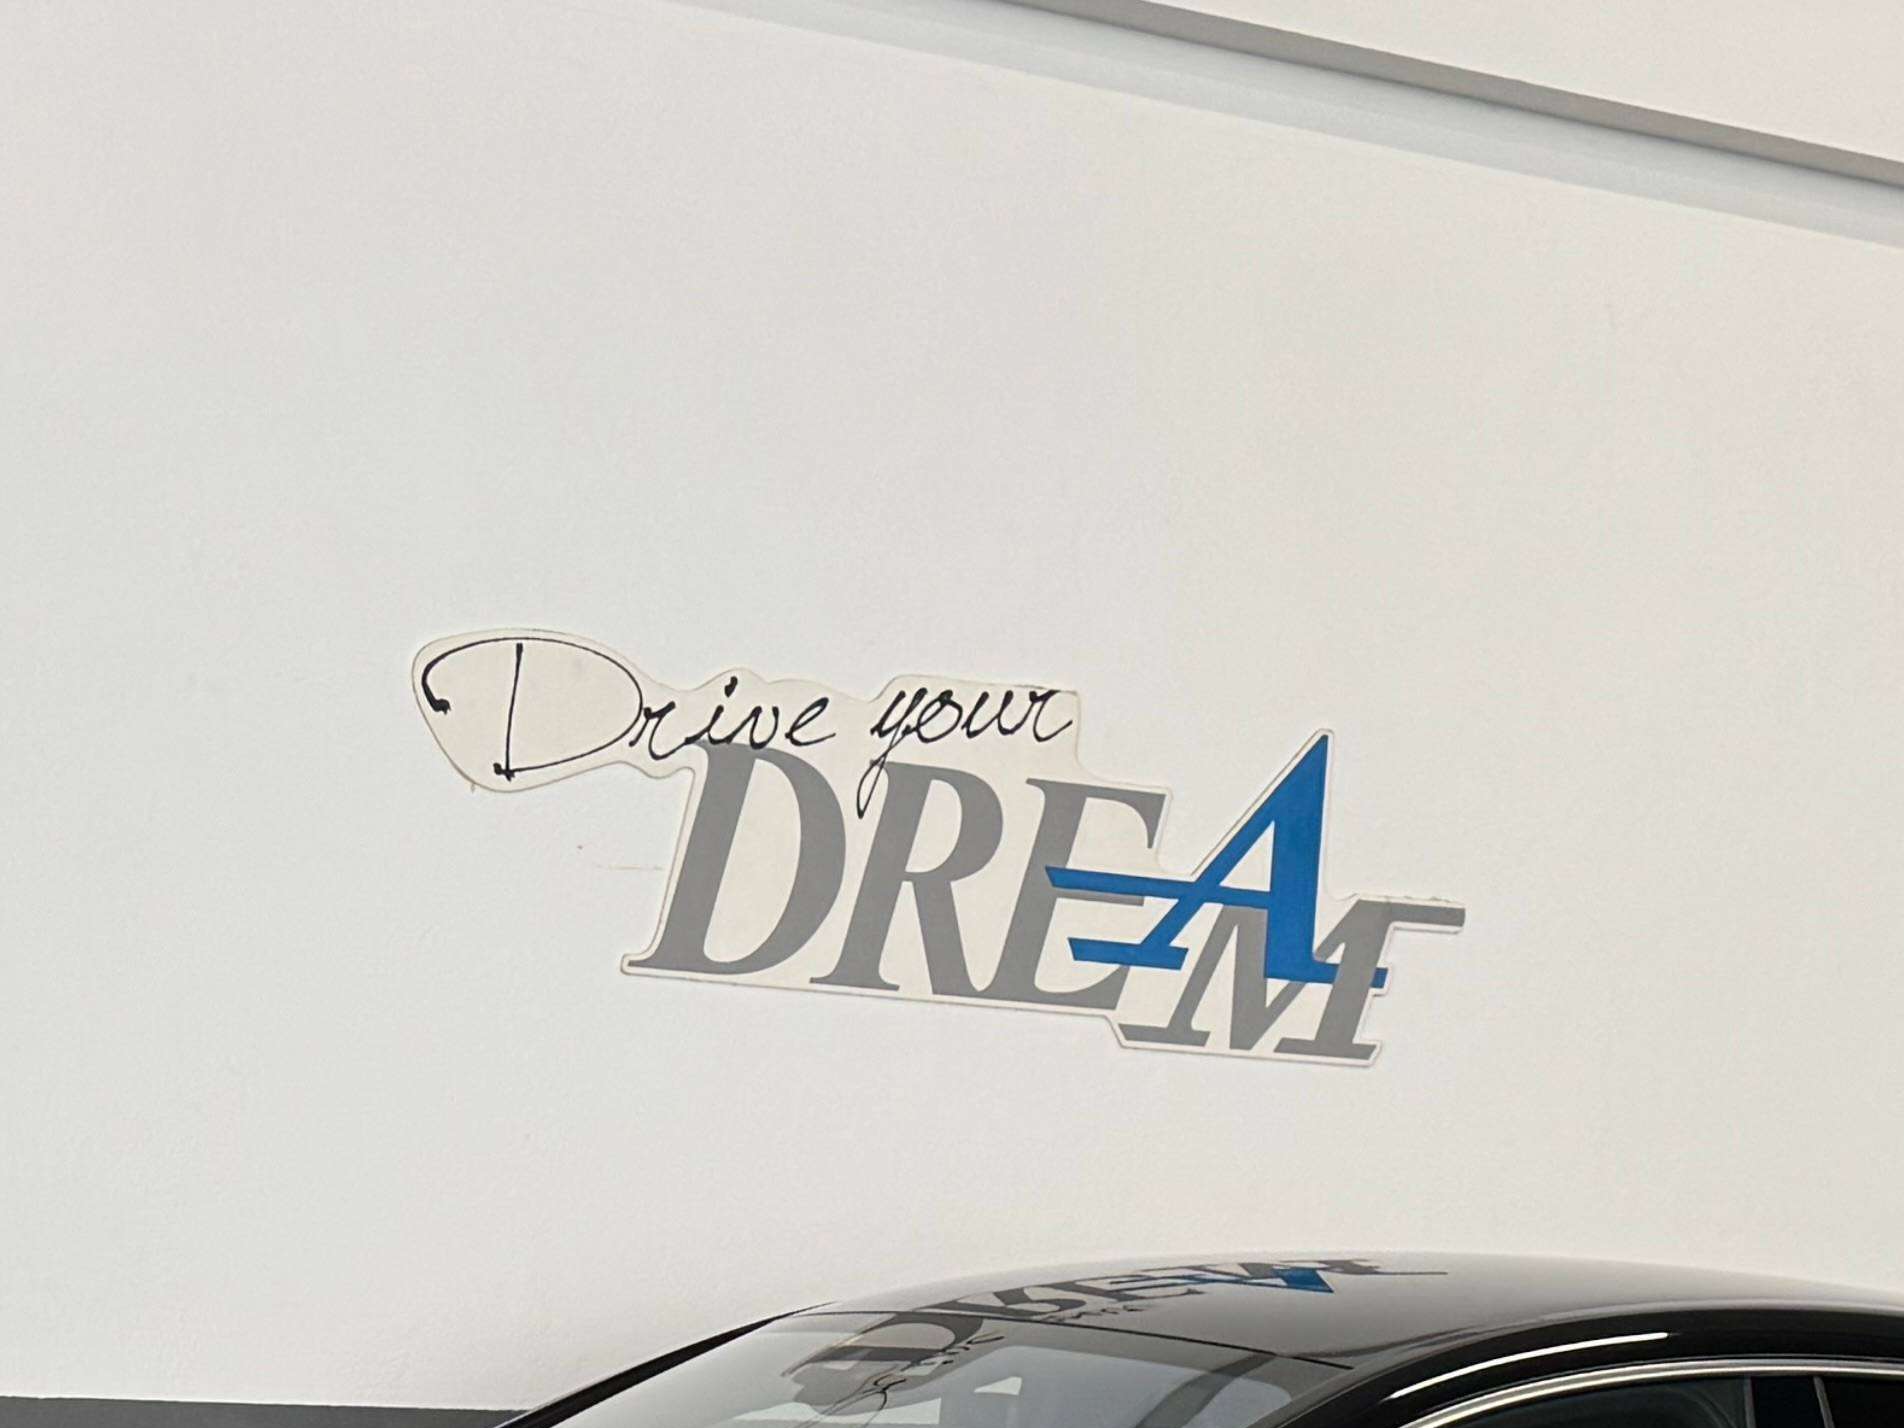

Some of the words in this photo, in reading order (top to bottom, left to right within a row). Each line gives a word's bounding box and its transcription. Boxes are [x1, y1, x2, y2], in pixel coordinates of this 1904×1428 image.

[421, 637, 836, 780] Drive
[856, 685, 1074, 819] your
[627, 734, 1466, 1061] DREAM
